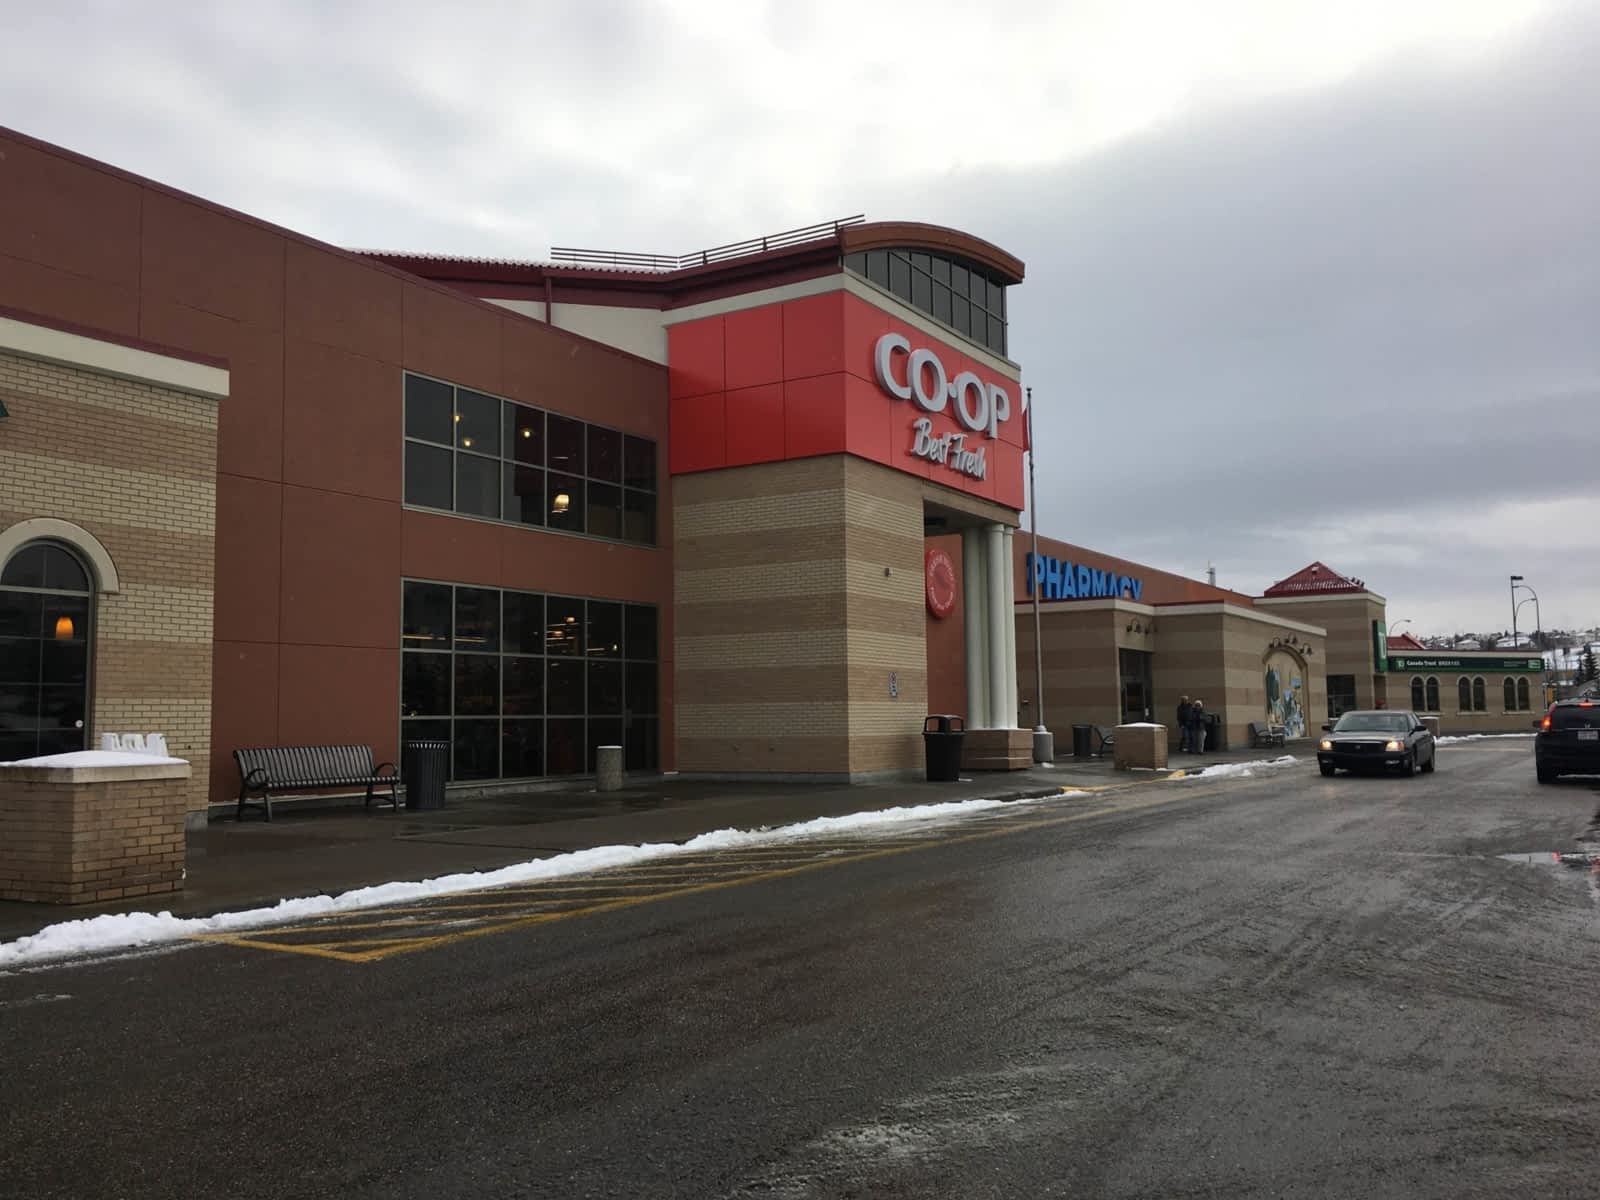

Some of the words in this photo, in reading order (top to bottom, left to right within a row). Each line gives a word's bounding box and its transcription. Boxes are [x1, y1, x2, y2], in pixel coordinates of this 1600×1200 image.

[875, 332, 1010, 439] CO-OP
[911, 417, 951, 465] Best
[950, 433, 986, 480] Fresh
[1027, 551, 1143, 601] PHARMACY
